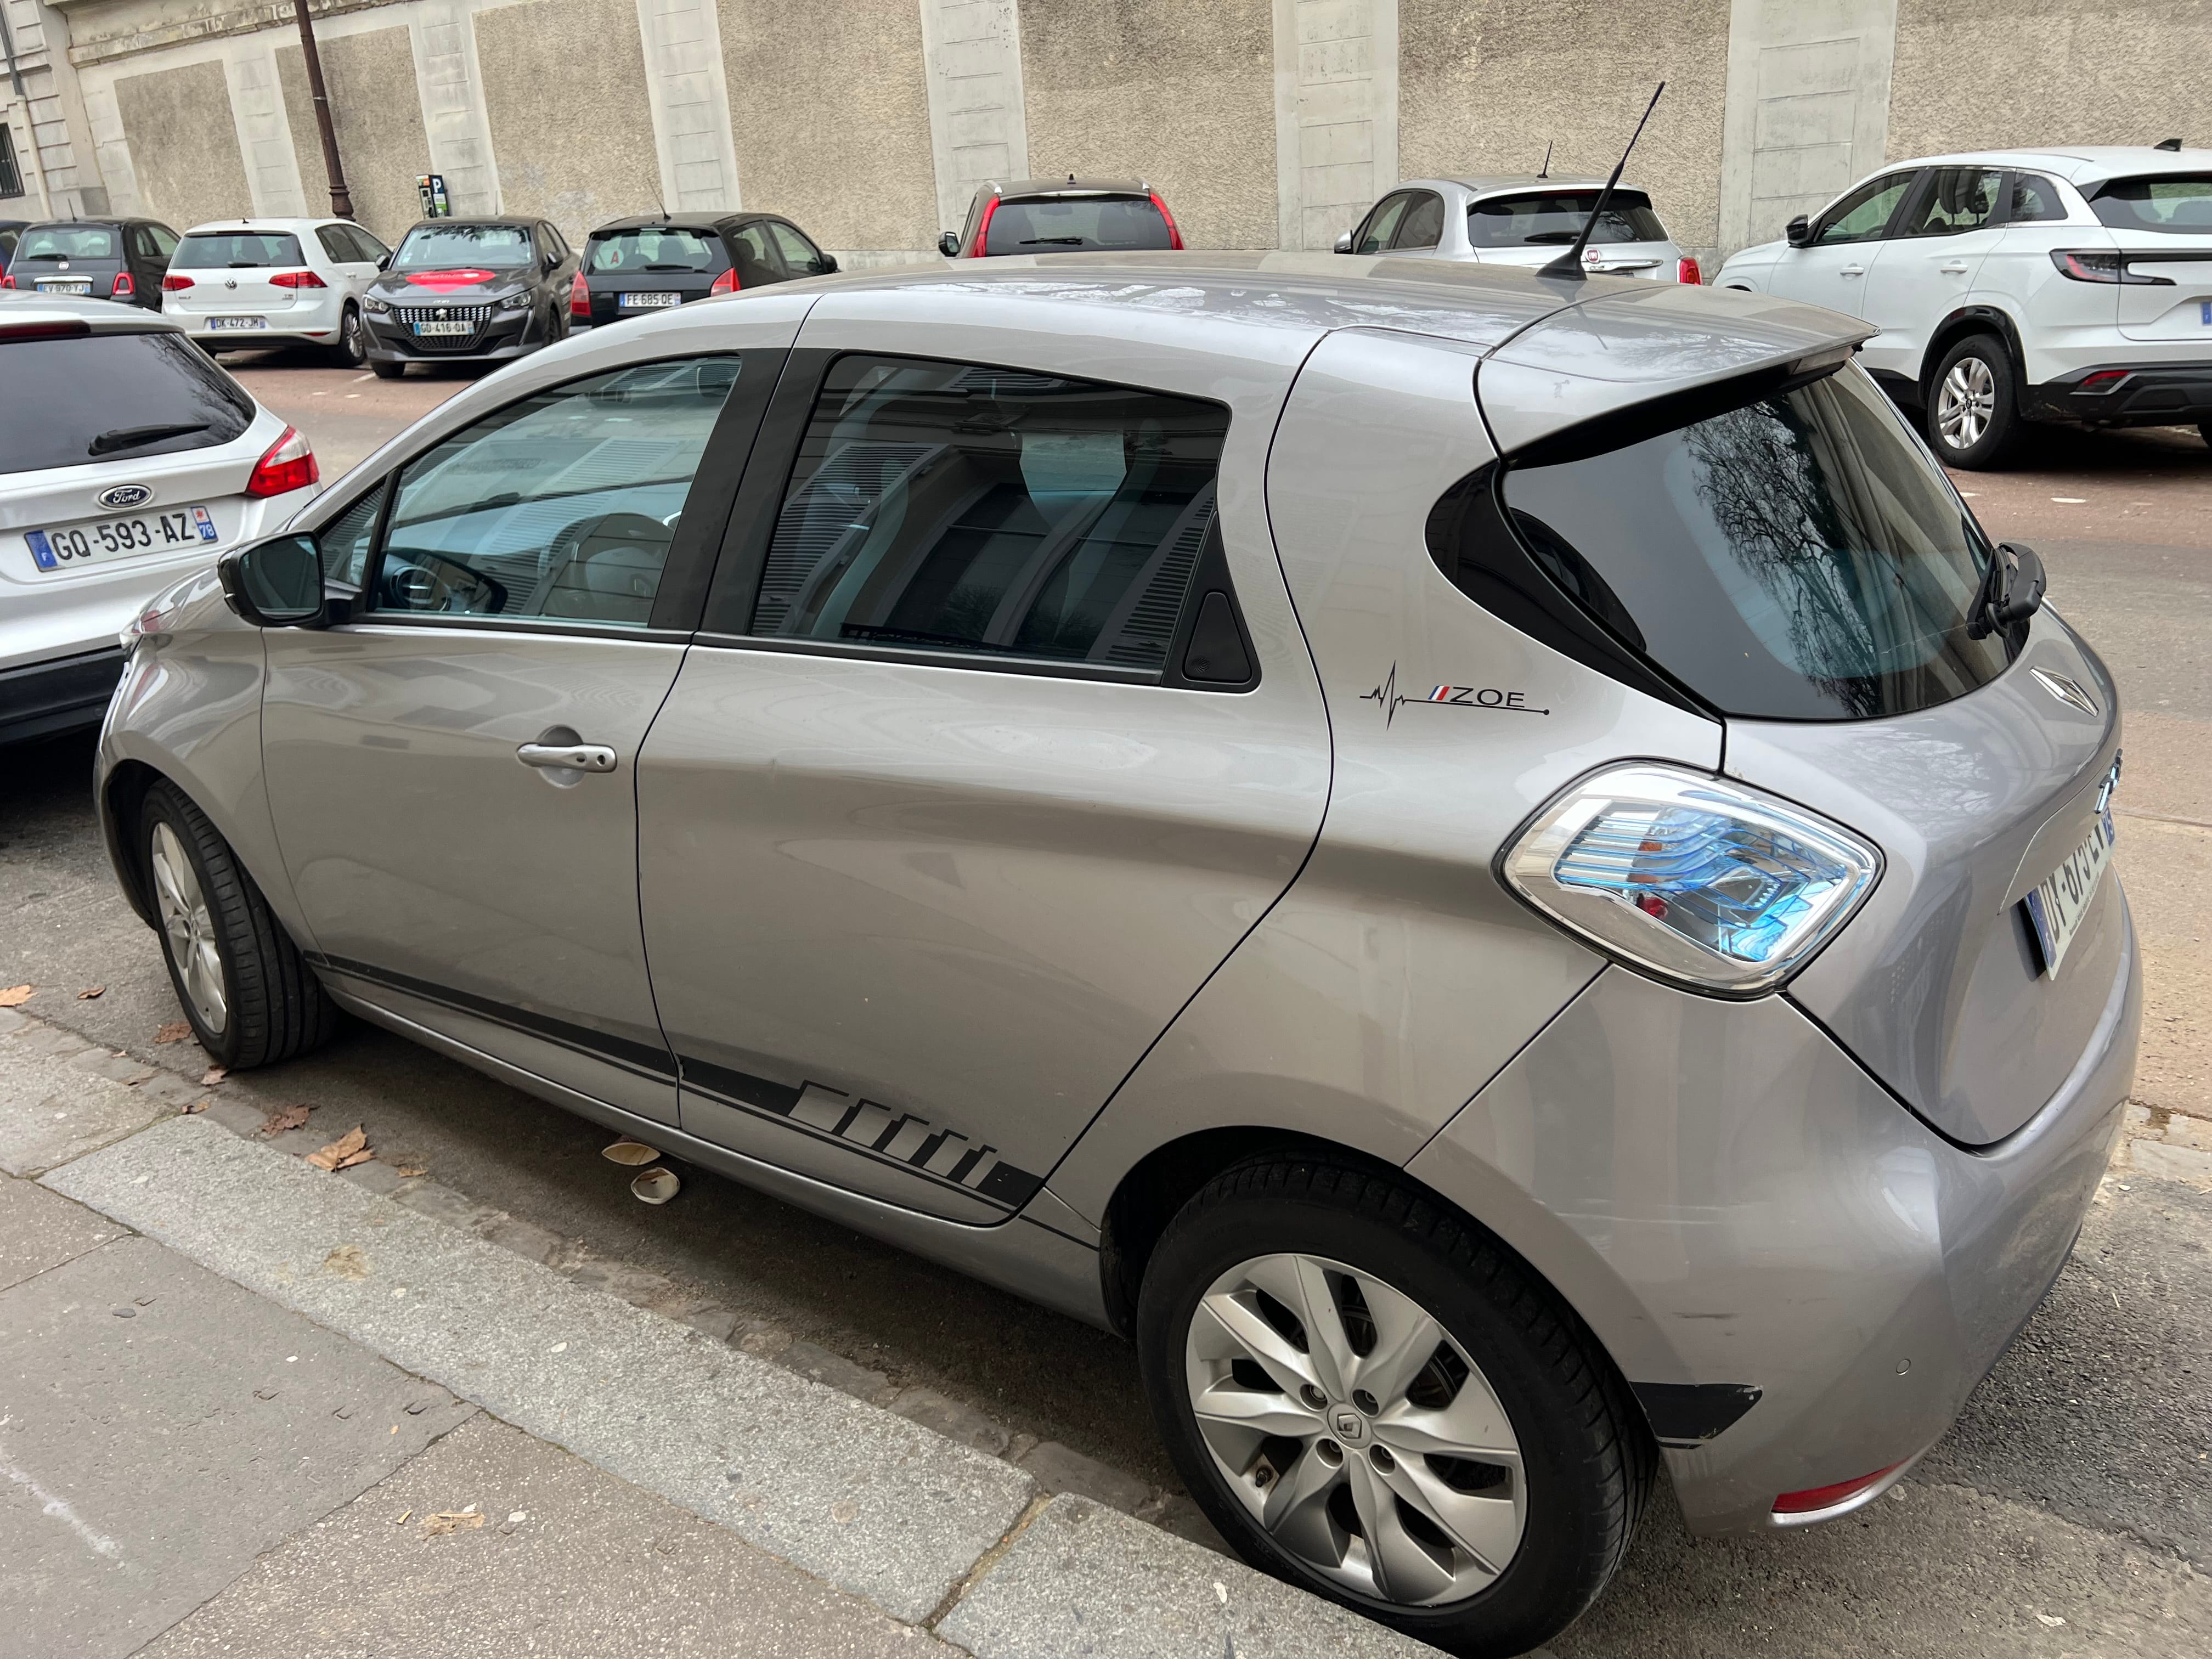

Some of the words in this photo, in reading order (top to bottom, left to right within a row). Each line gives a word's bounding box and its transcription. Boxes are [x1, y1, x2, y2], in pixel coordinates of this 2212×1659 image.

[432, 178, 442, 193] P
[611, 250, 619, 263] A
[113, 489, 140, 504] Ford
[51, 513, 195, 560] GQ-593-AZ
[200, 524, 215, 538] 78
[42, 552, 48, 562] F
[1450, 686, 1525, 708] ZOE
